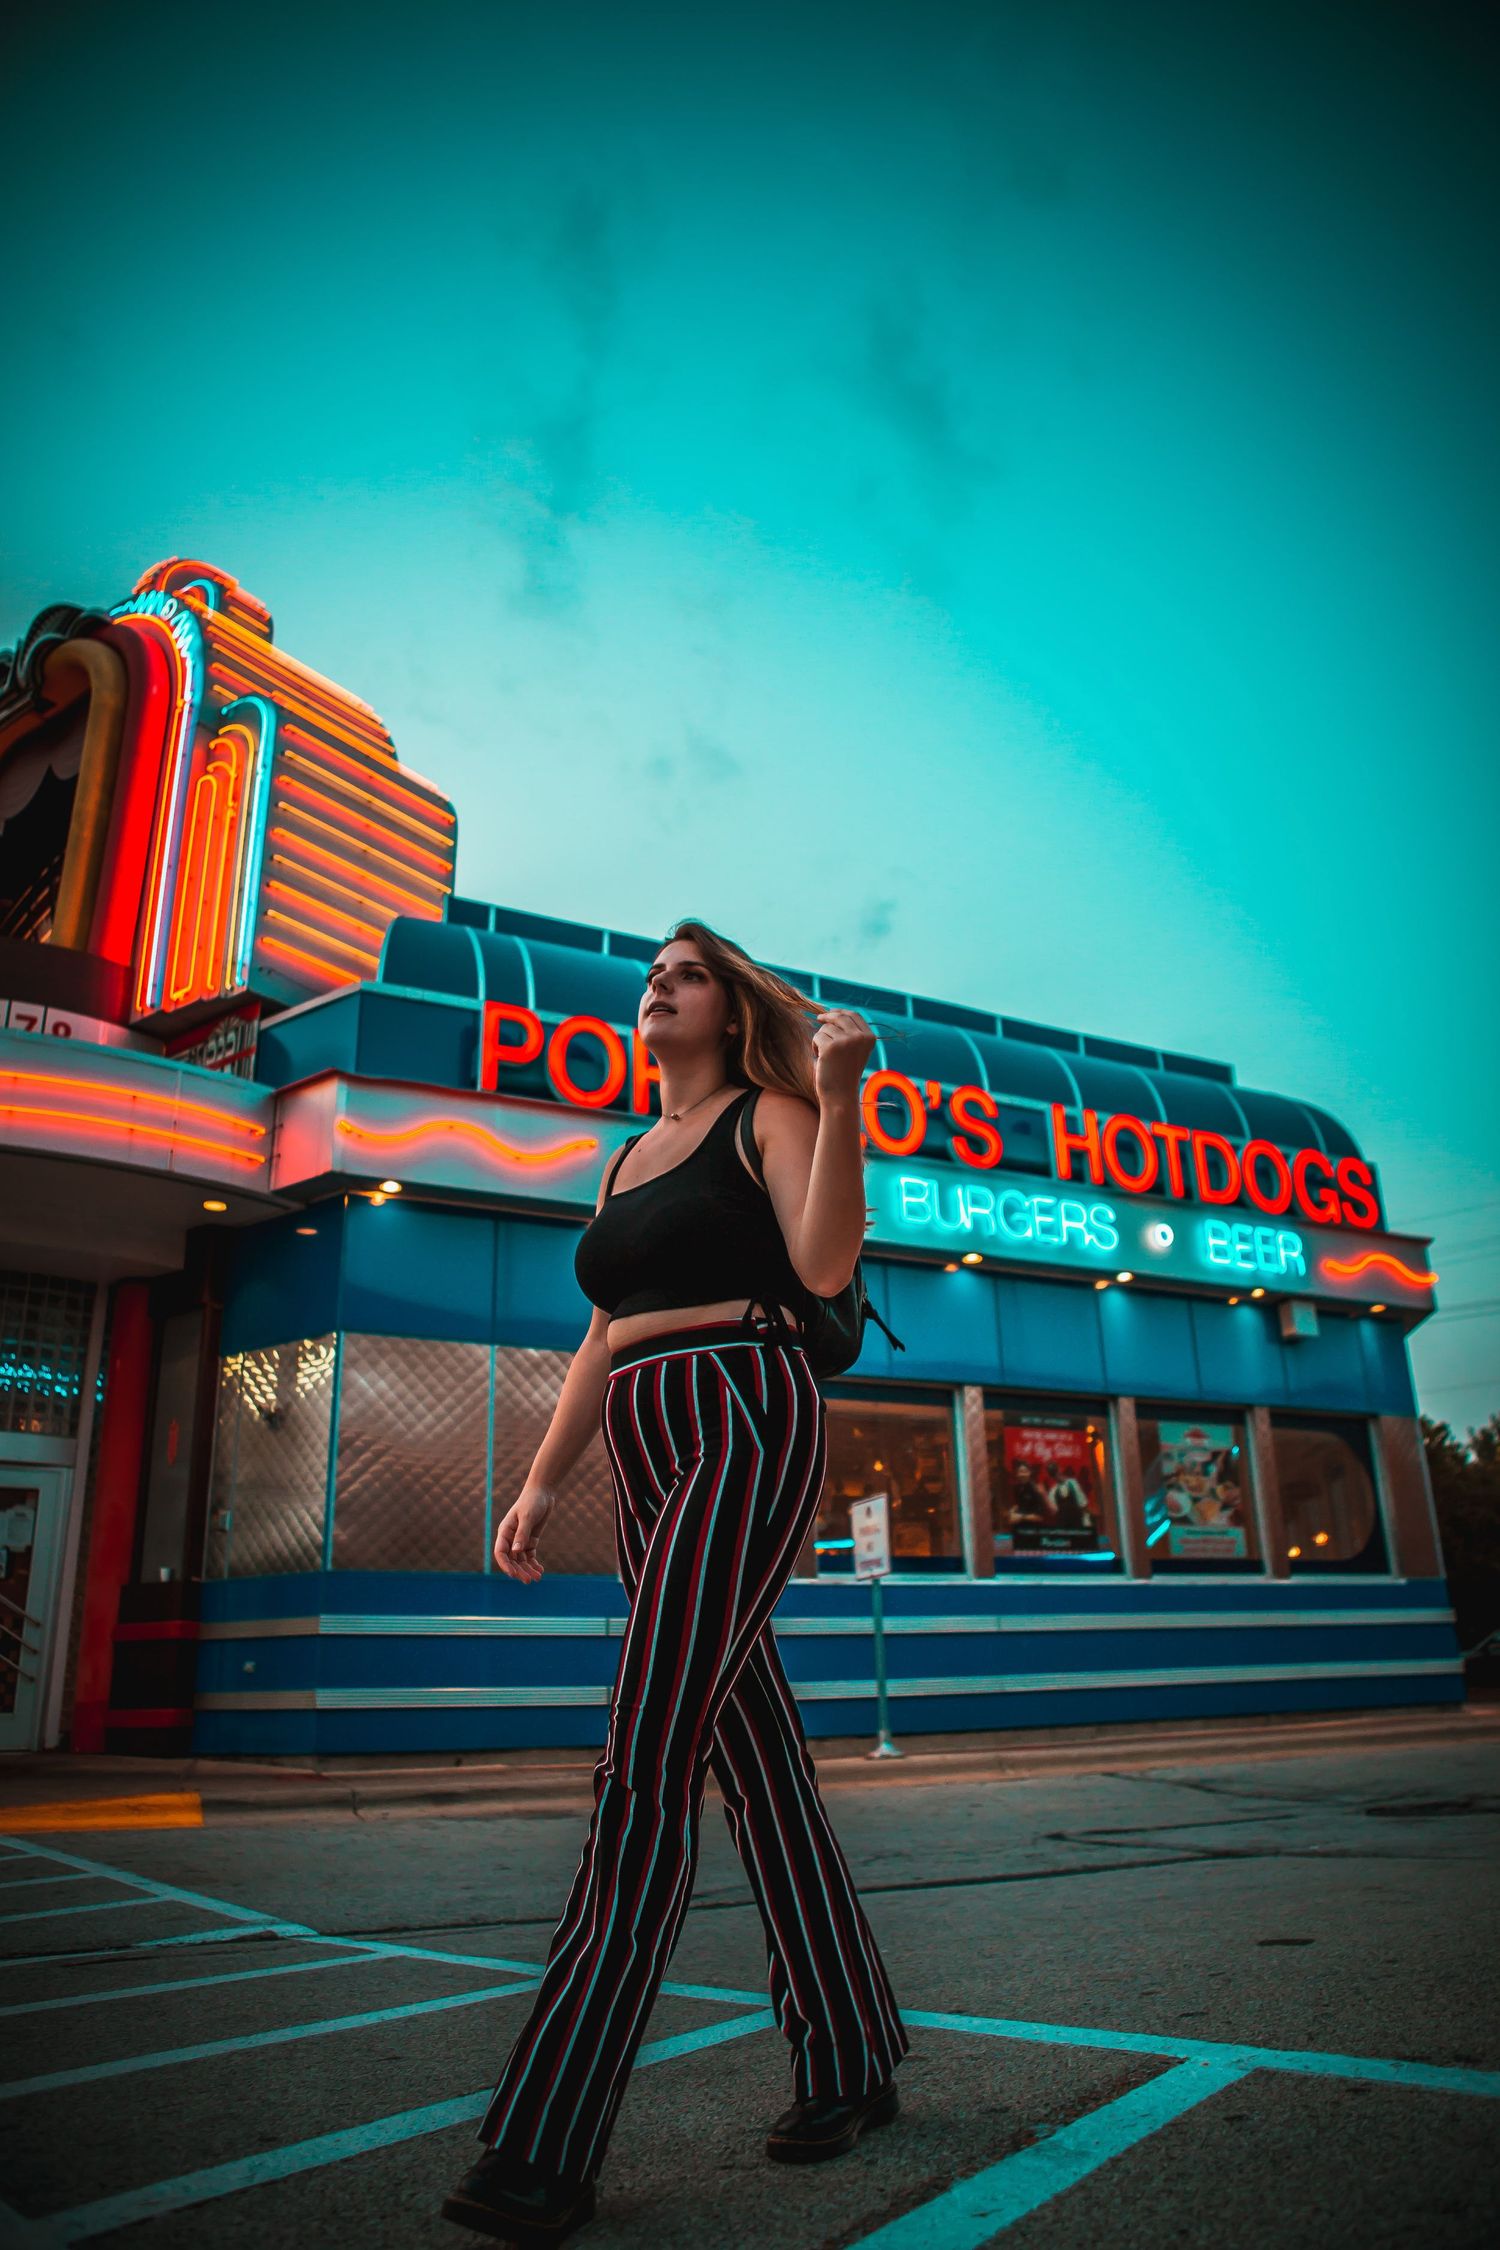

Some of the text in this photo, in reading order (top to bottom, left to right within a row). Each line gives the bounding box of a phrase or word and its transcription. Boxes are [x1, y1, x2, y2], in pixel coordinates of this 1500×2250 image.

[1050, 1103, 1379, 1229] HOTDOGS
[900, 1176, 1306, 1275] BURGERS BEER
